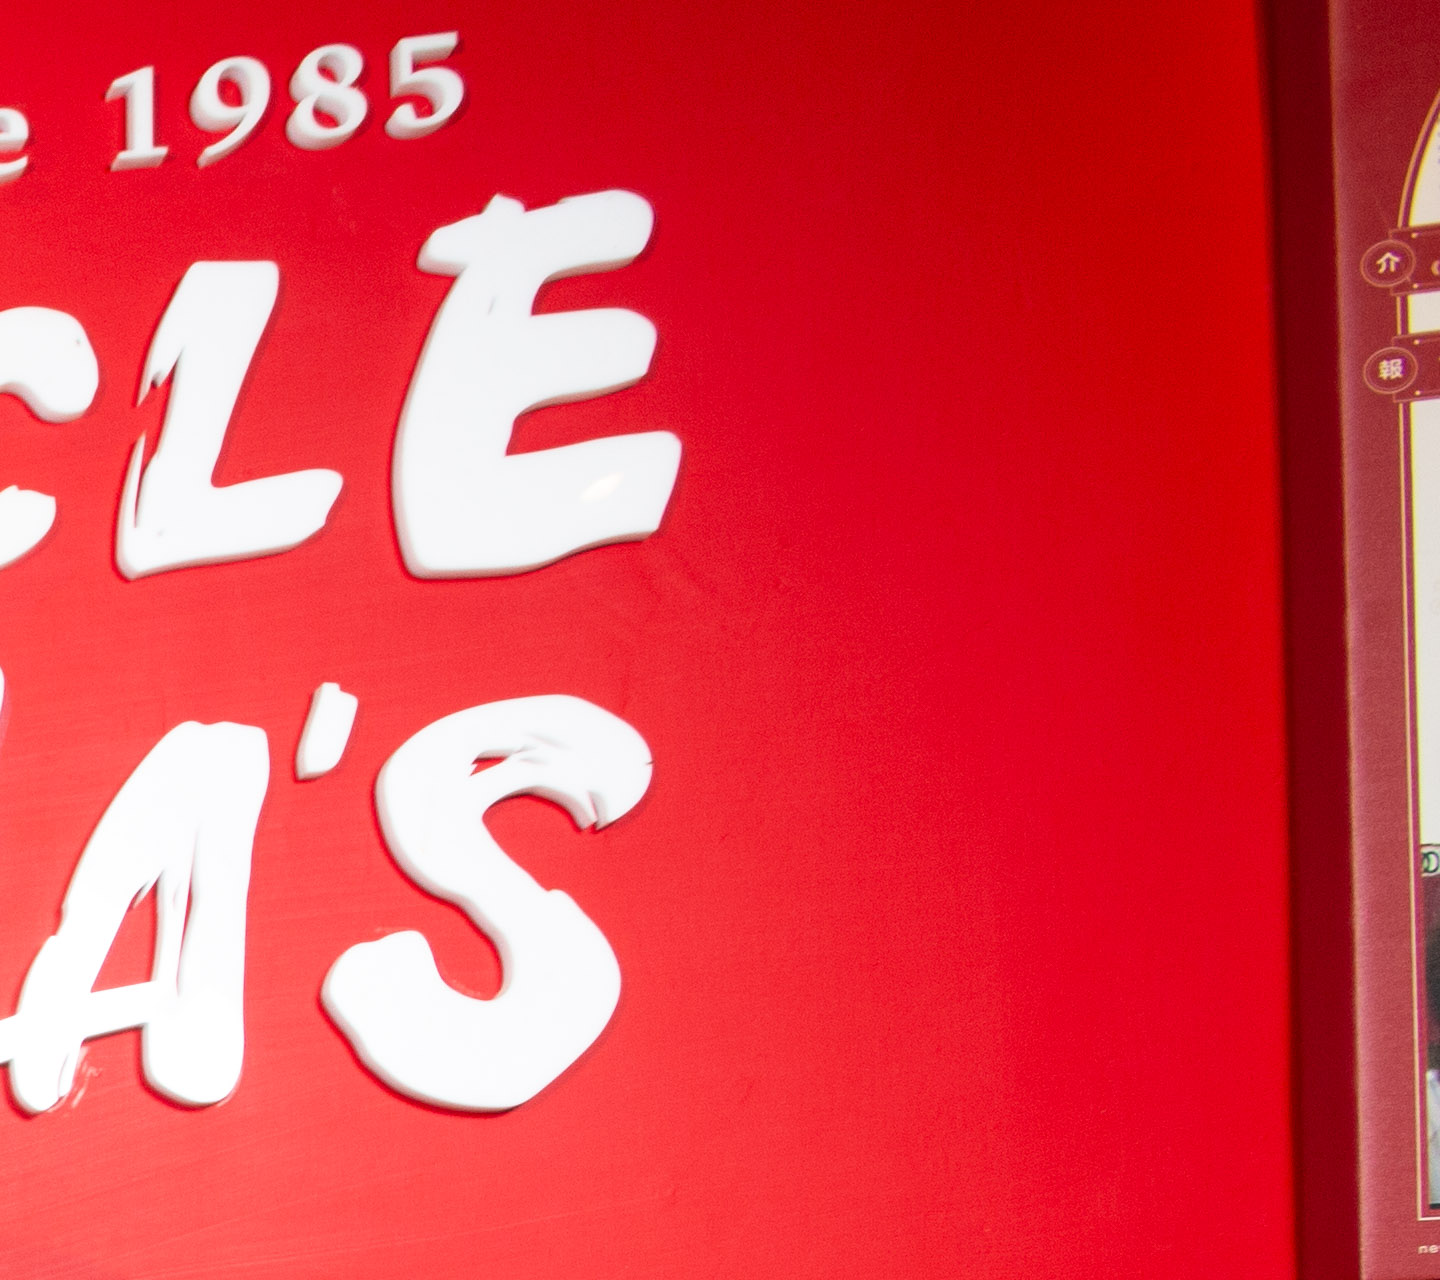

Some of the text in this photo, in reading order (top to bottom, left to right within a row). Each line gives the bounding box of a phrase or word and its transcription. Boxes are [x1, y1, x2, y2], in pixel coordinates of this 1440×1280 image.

[102, 32, 470, 172] 1985
[1377, 252, 1398, 274] 介
[1379, 359, 1403, 380] 報
